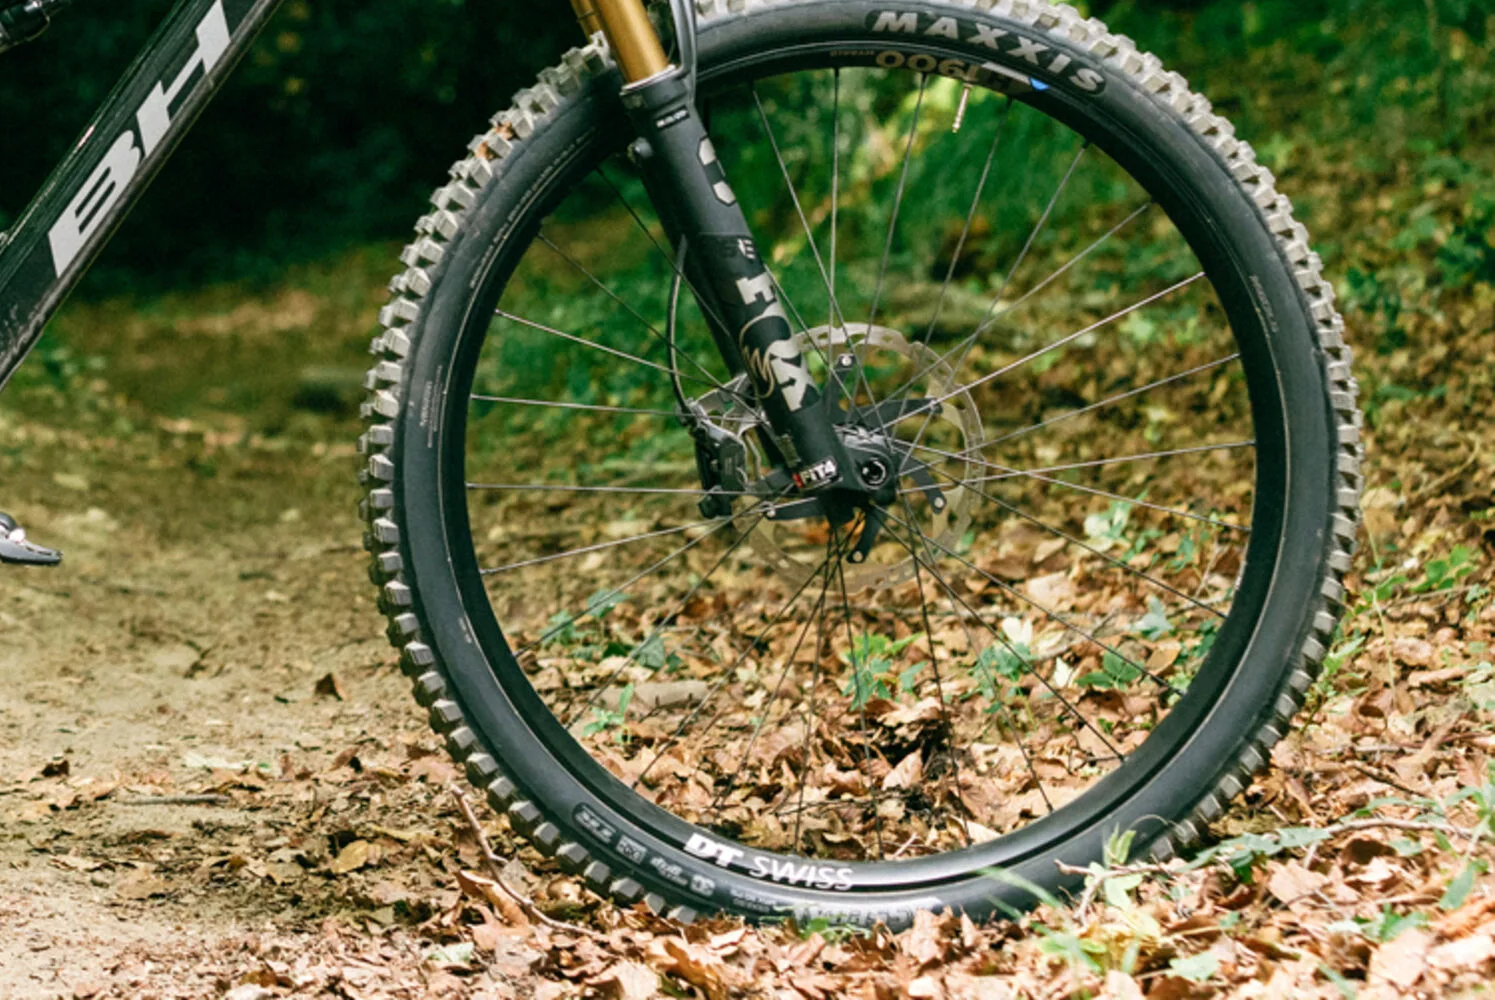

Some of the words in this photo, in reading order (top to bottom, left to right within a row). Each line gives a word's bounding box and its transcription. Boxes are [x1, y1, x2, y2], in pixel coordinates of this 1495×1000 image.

[872, 11, 1104, 92] MAXXIS
[683, 833, 744, 867] DT
[749, 855, 854, 891] SWISS
